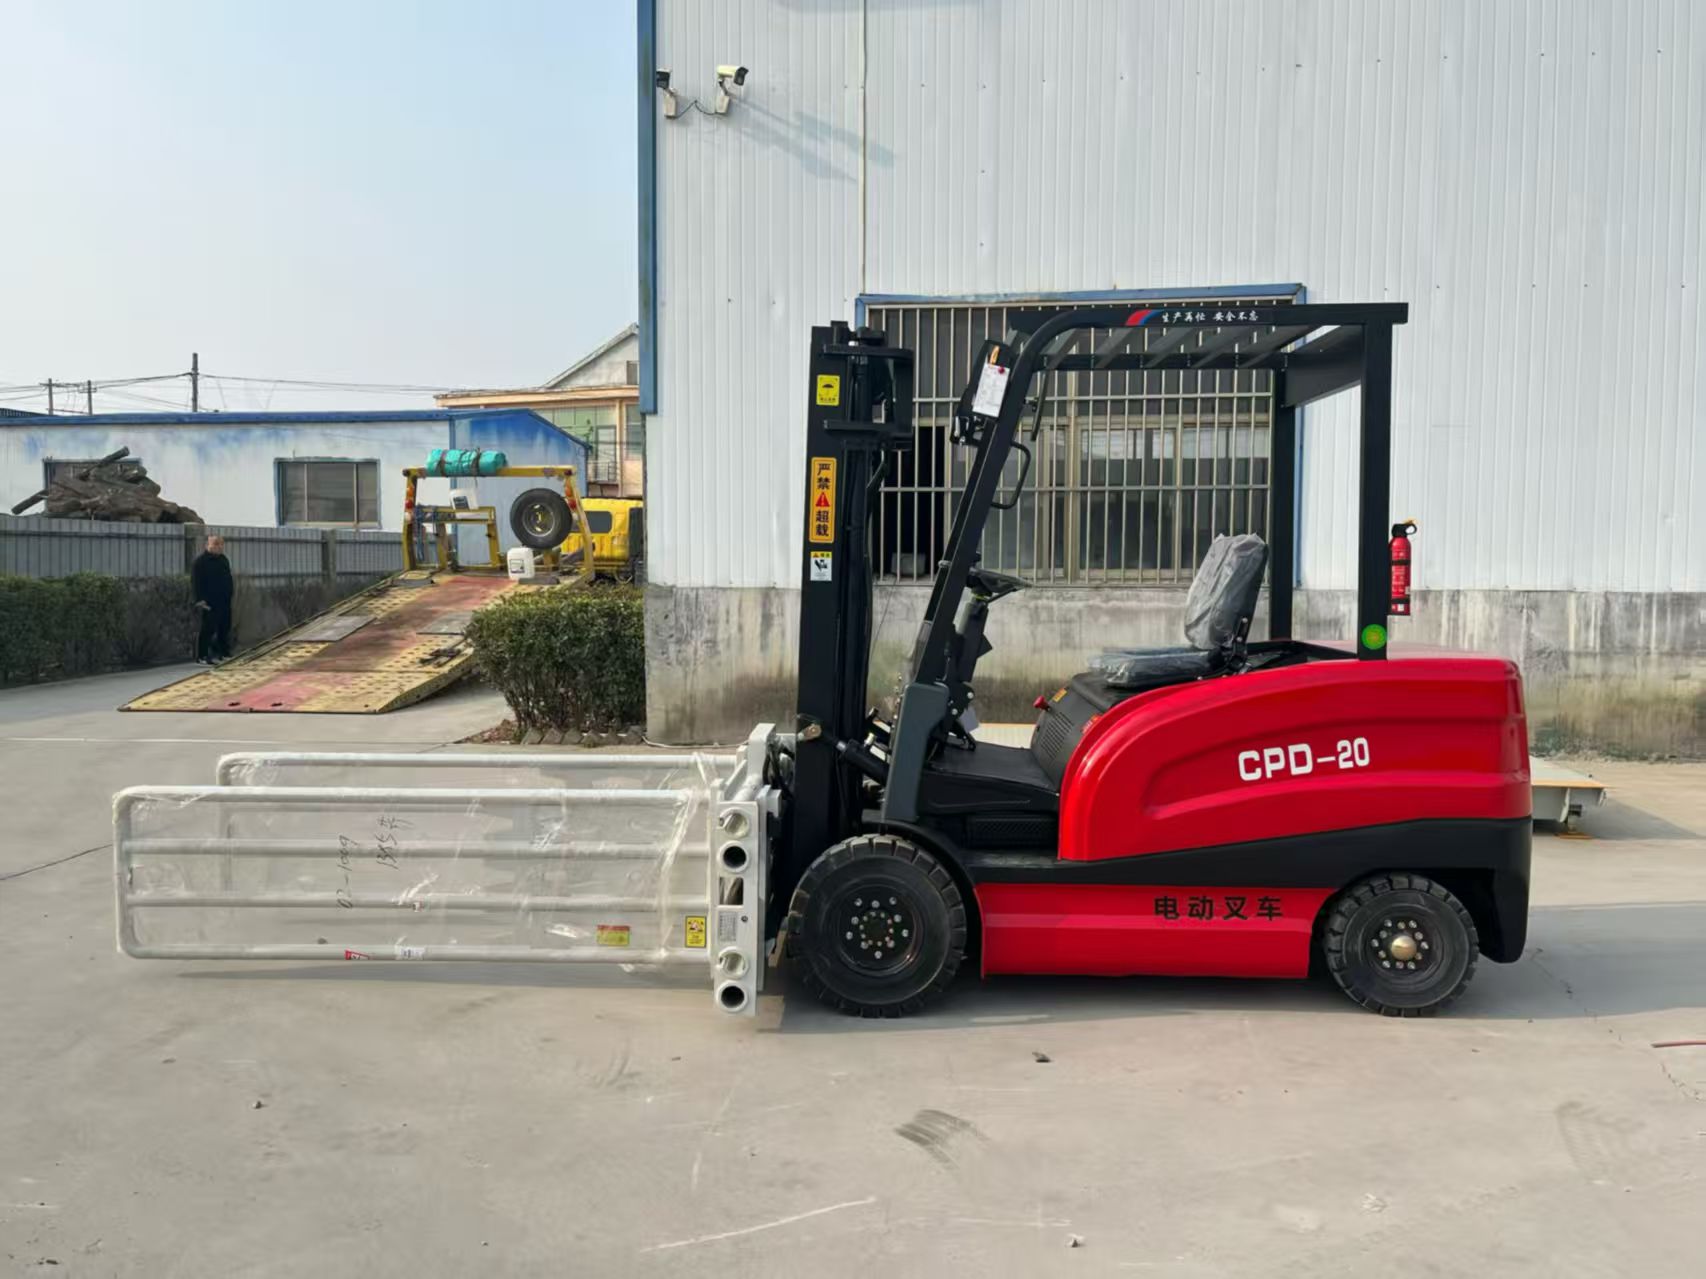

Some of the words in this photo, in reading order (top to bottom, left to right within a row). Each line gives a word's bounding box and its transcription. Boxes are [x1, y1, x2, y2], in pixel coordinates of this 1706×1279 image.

[1213, 310, 1258, 322] 安全不忘
[1238, 737, 1370, 781] CPD-20
[1154, 896, 1283, 921] 电动叉车
